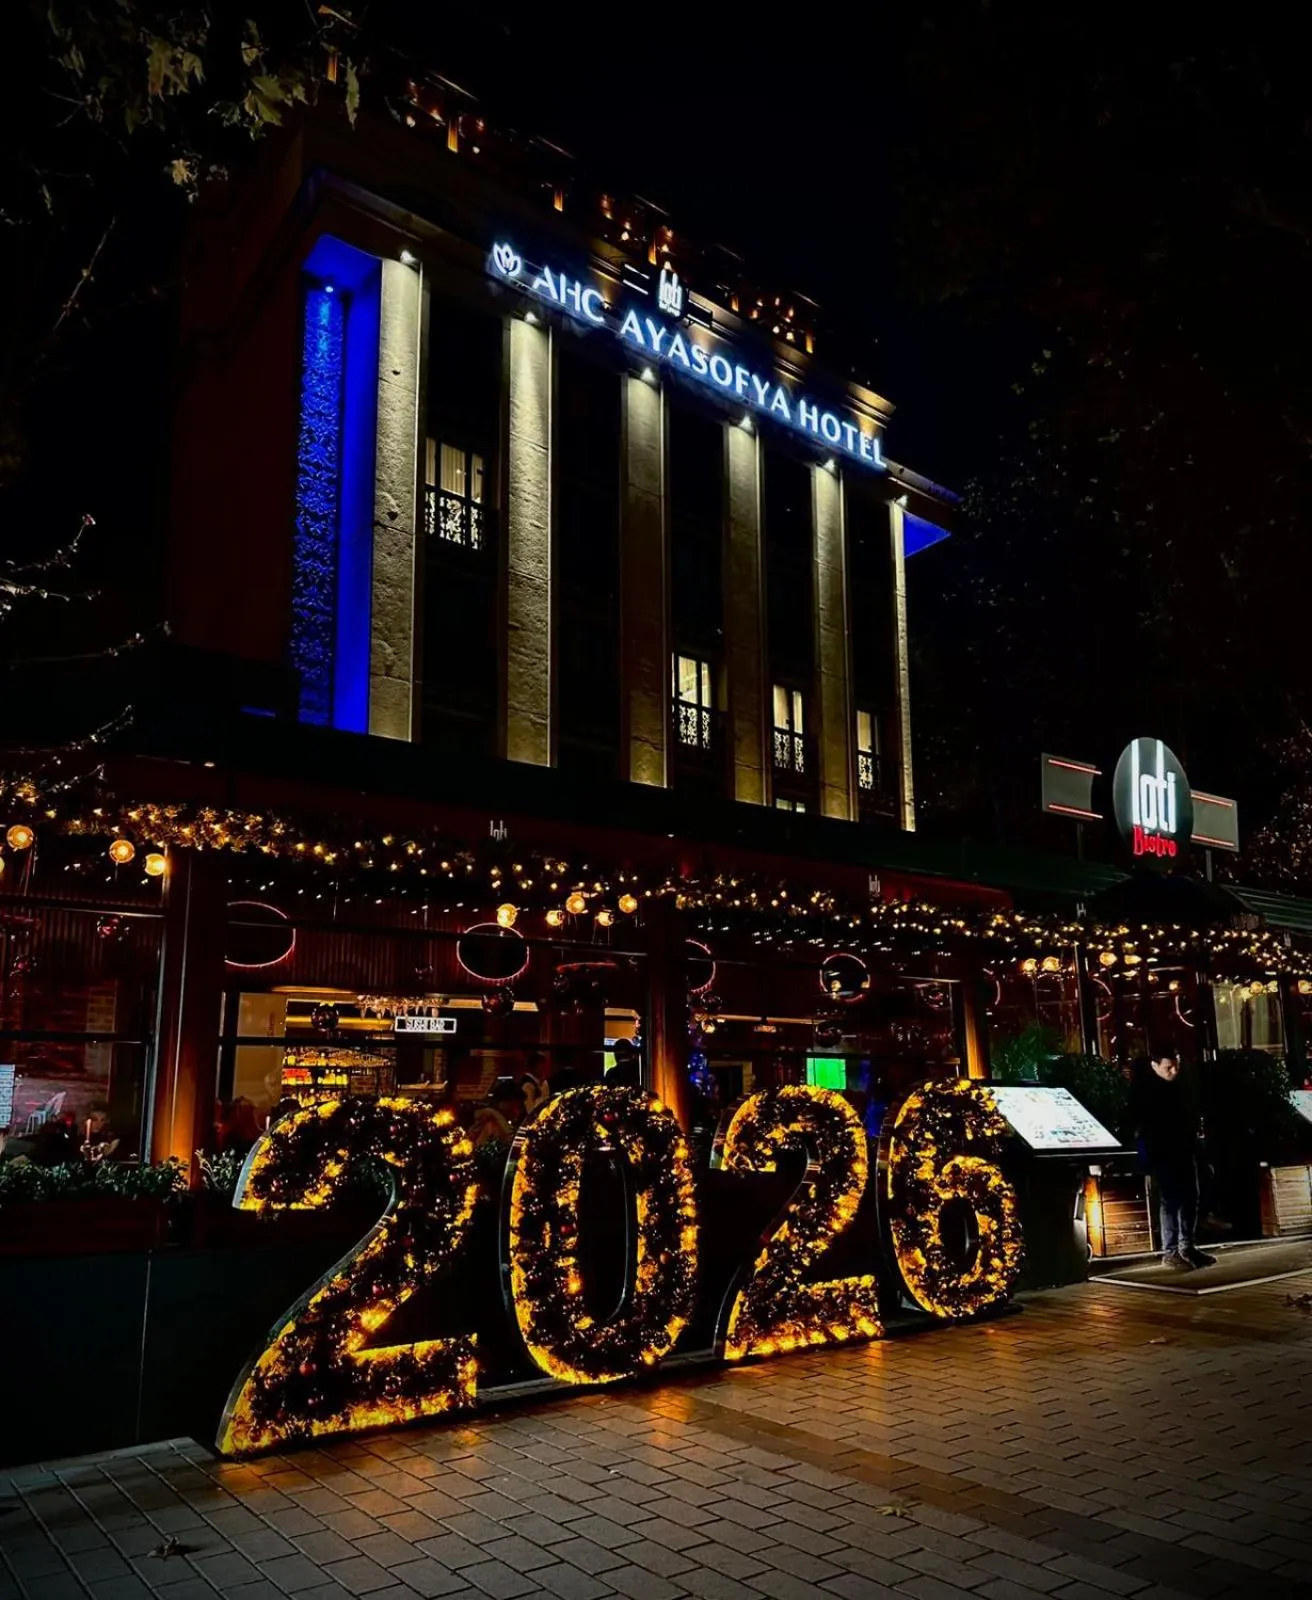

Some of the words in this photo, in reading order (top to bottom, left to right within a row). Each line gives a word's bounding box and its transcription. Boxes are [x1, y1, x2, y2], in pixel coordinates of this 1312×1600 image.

[532, 265, 605, 323] AHC
[620, 309, 792, 420] AYASOFYA
[799, 398, 887, 468] HOTEL
[1131, 738, 1177, 834] loti
[1133, 825, 1177, 857] Bistro
[215, 1080, 1023, 1458] 2026
